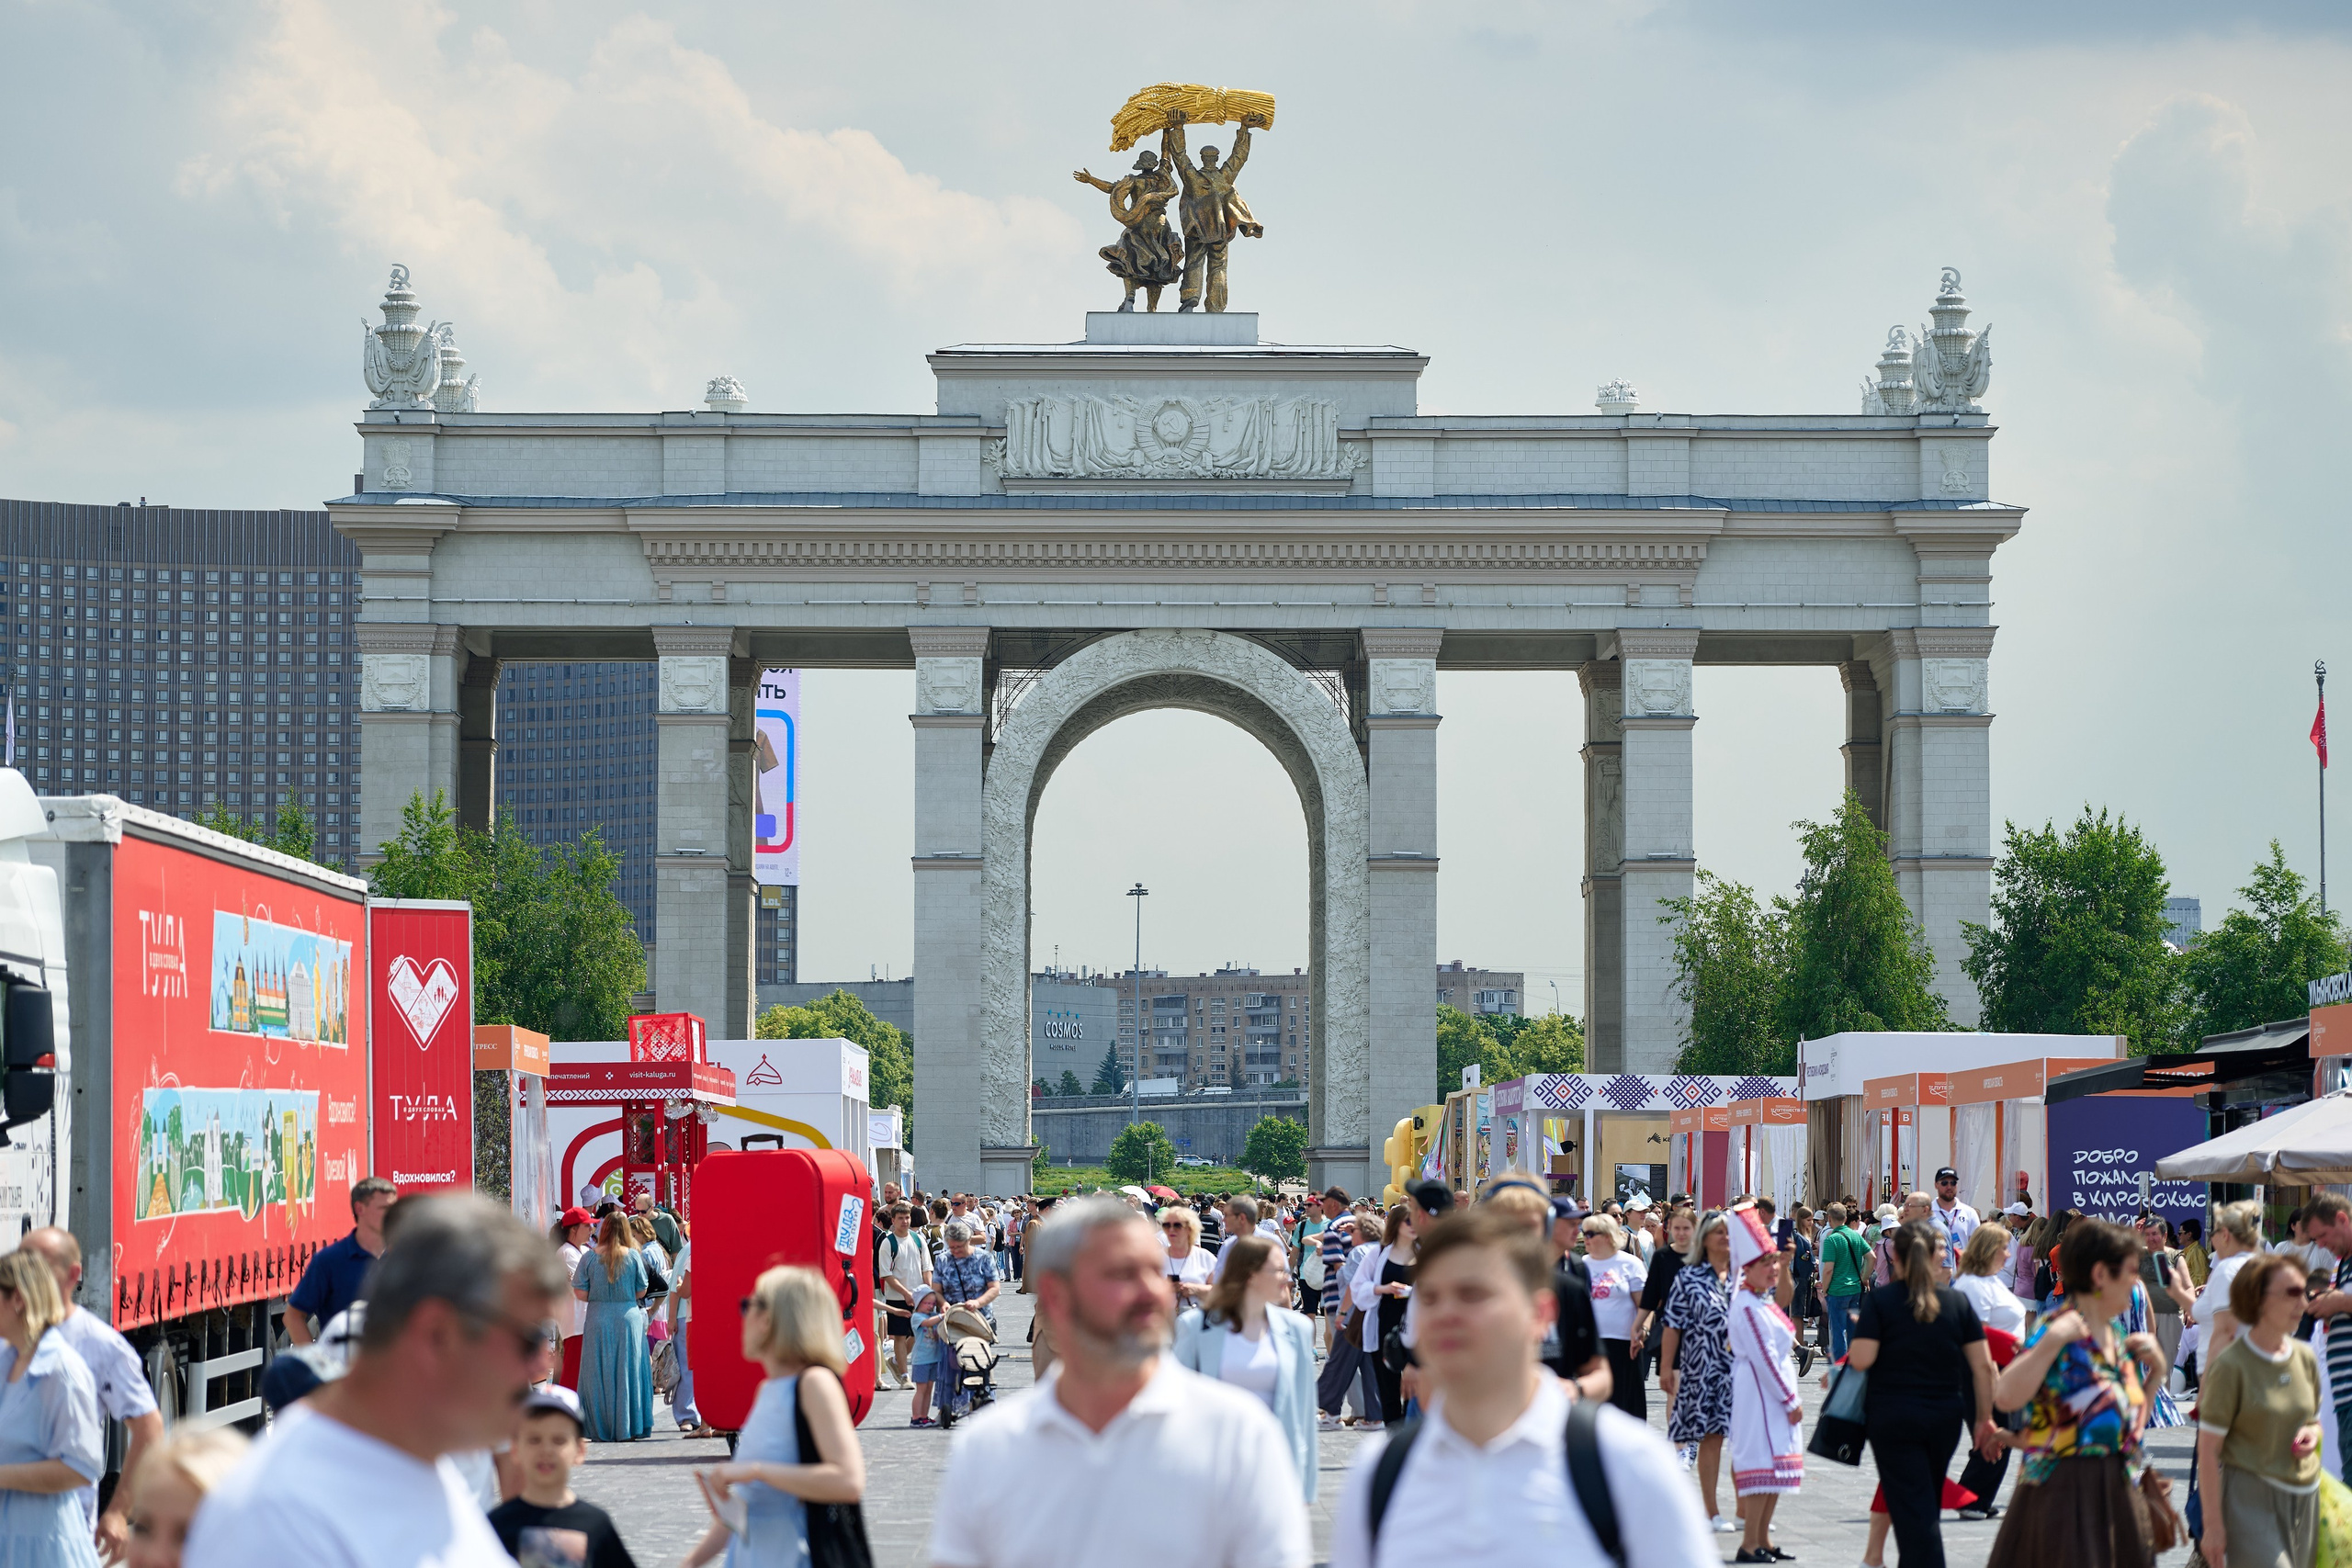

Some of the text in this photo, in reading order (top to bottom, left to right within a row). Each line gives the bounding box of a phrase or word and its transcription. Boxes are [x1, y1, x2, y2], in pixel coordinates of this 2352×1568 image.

[139, 909, 187, 998] ТУЛА
[1045, 1021, 1083, 1039] COSMOS
[628, 1071, 676, 1079] visit-kaluga.ru
[390, 1095, 458, 1121] ТУЛА
[2072, 1148, 2139, 1164] ДОБРО
[392, 1169, 456, 1185] Вдохновился?
[2072, 1168, 2191, 1187] ПОЖАЛОВ
[2072, 1191, 2086, 1207] В
